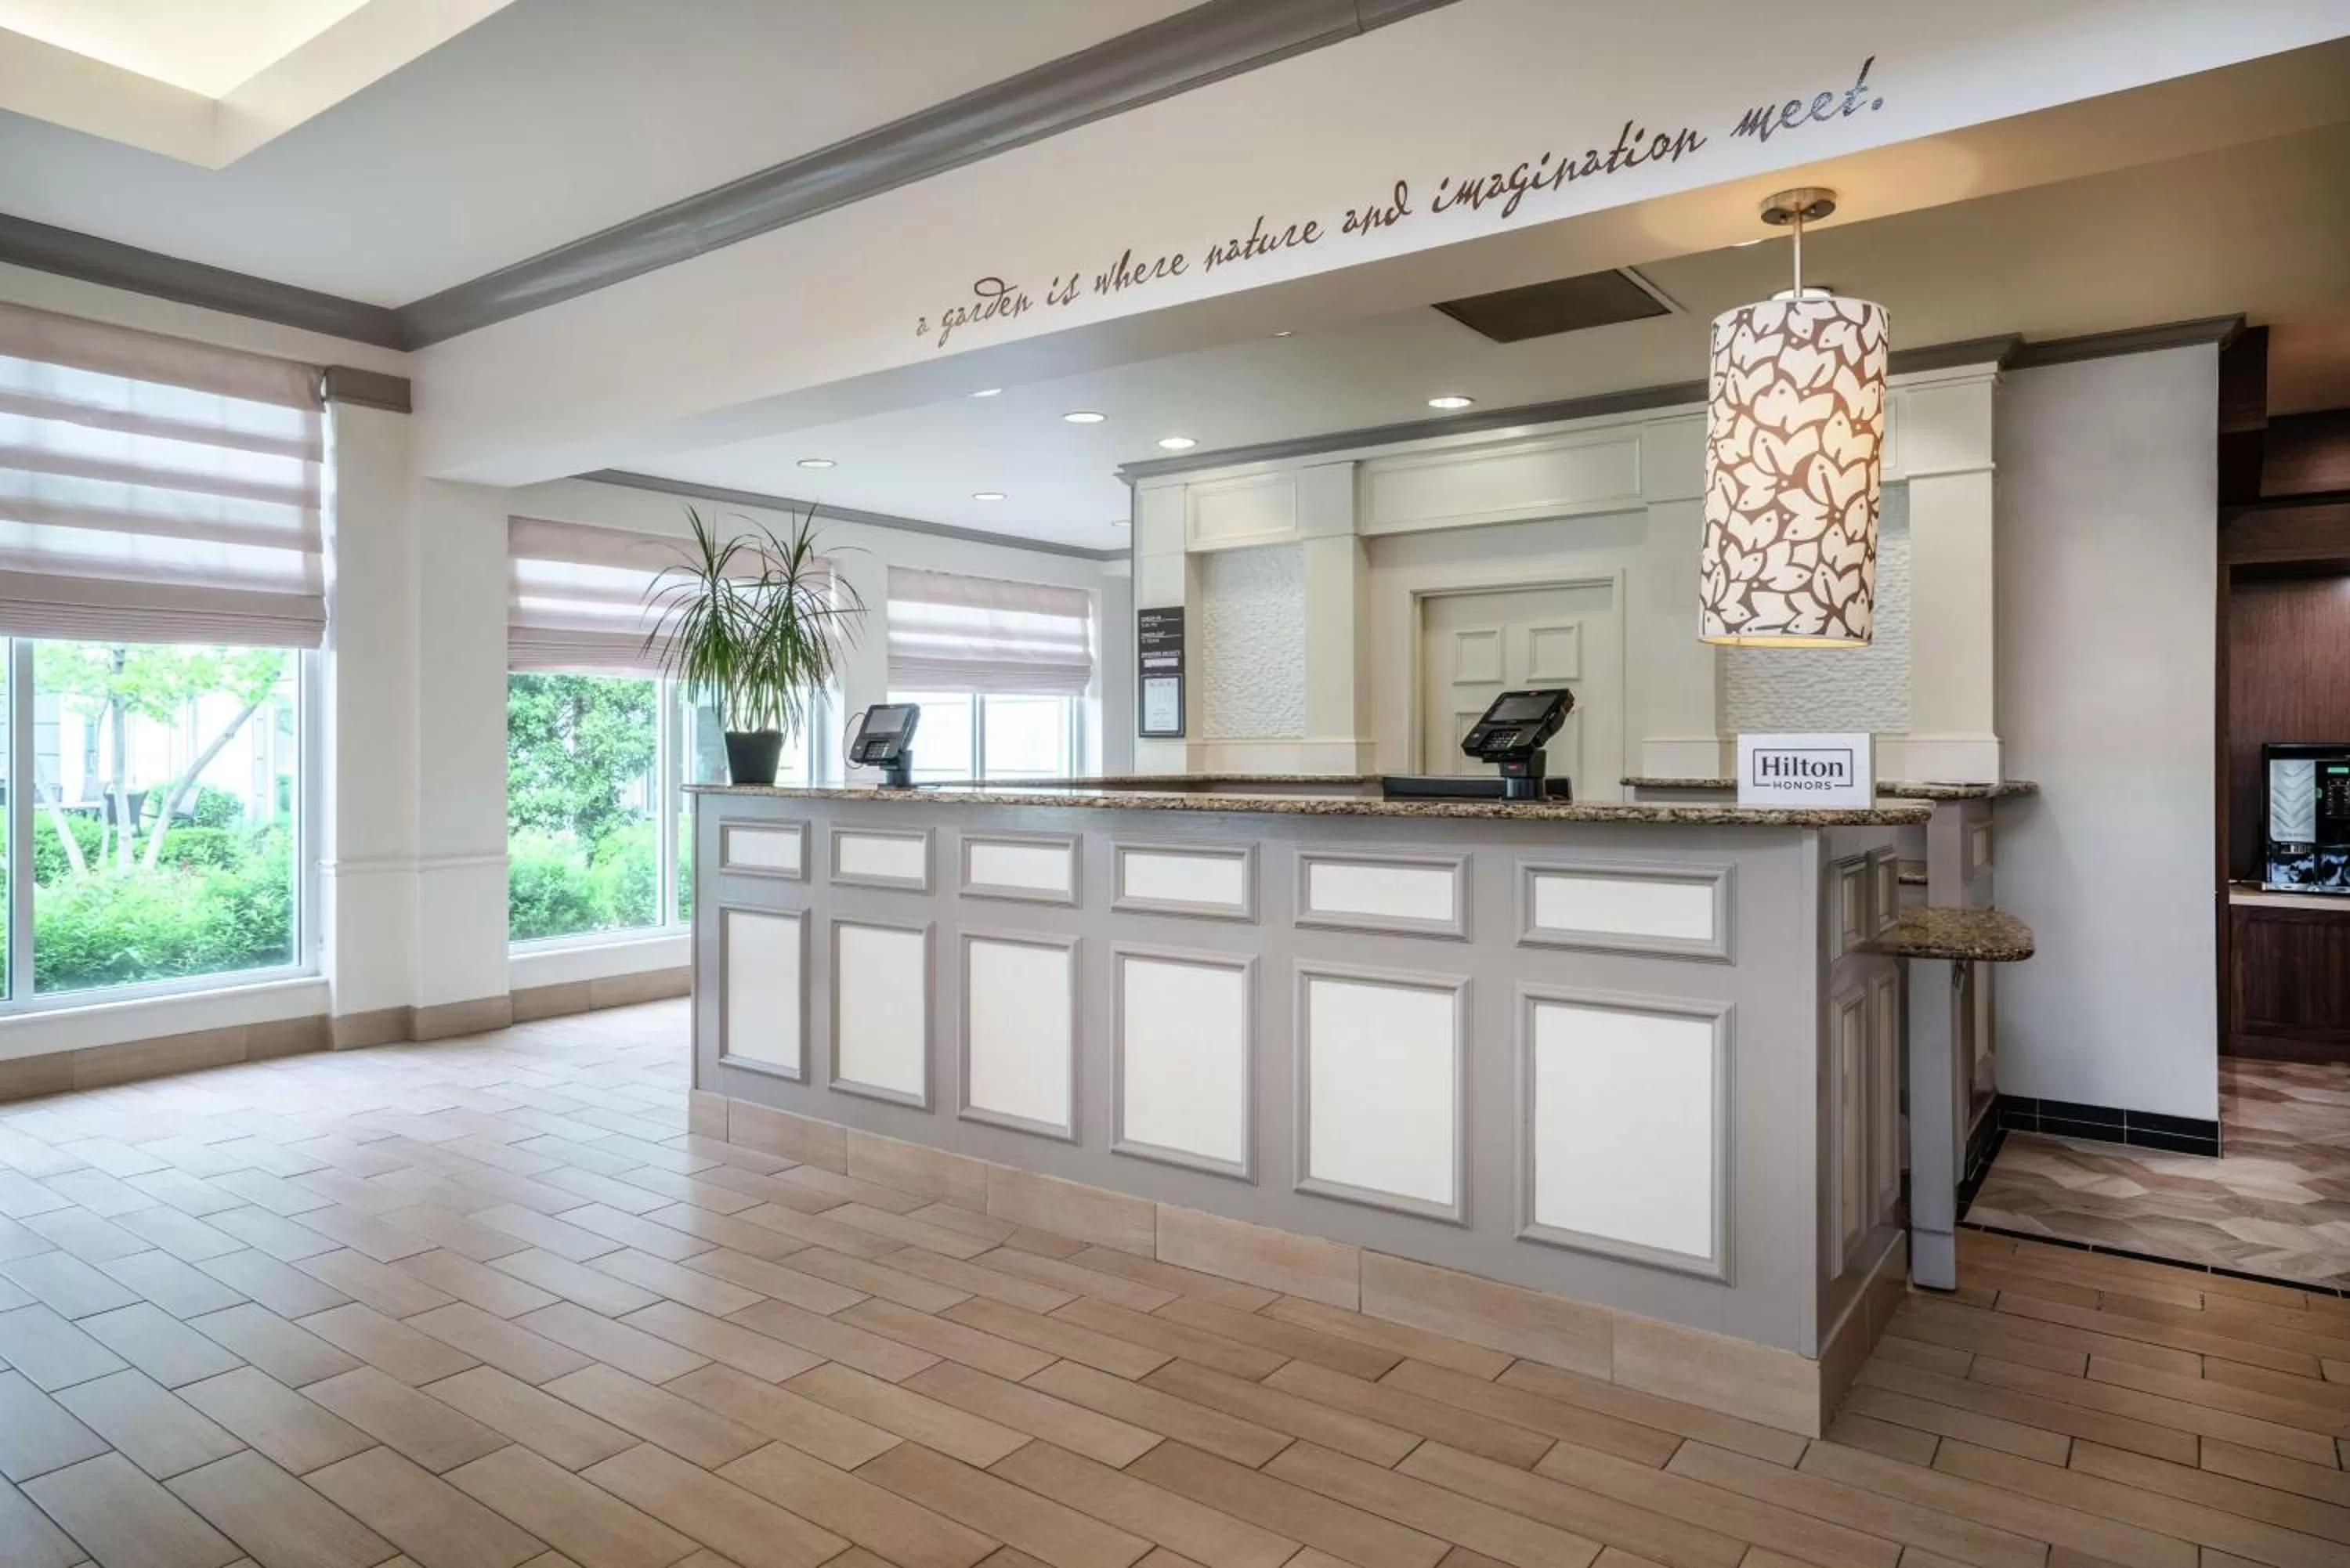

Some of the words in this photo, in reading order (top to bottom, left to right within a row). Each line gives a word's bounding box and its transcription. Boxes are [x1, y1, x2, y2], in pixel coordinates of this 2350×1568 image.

[916, 316, 931, 337] a
[938, 276, 1033, 348] garden
[1047, 273, 1080, 305] is
[1093, 249, 1190, 295] where
[1204, 215, 1325, 273] nature
[1342, 179, 1413, 236] and
[1431, 121, 1707, 219] imagination
[1730, 56, 1884, 142] meet.
[1761, 756, 1843, 777] Hilton
[1773, 781, 1831, 790] HONORS
